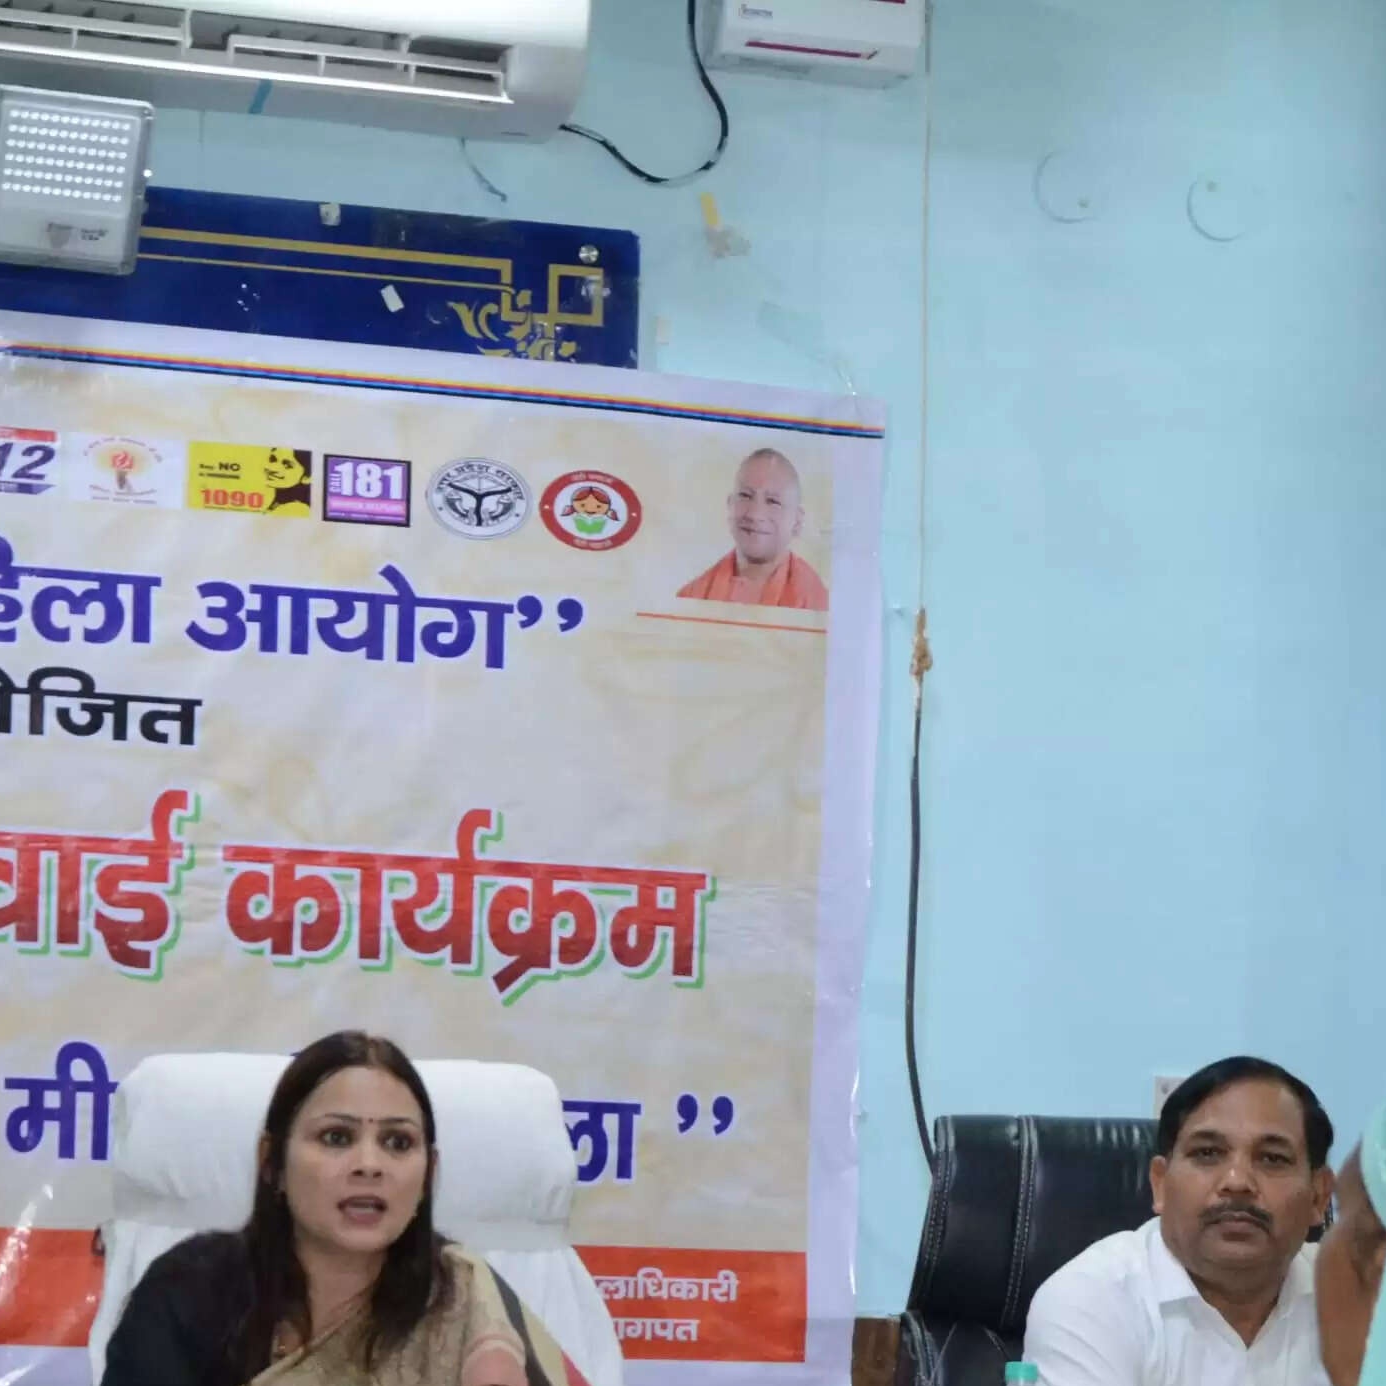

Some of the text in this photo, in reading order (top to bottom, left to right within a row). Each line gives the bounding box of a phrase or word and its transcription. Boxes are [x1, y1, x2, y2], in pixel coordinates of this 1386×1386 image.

[200, 487, 265, 509] 1090
[334, 461, 403, 500] 181
[222, 808, 709, 992] कार्यक्रम
[594, 1267, 739, 1303] लाधिकारी
[612, 1316, 701, 1342] ागपत
